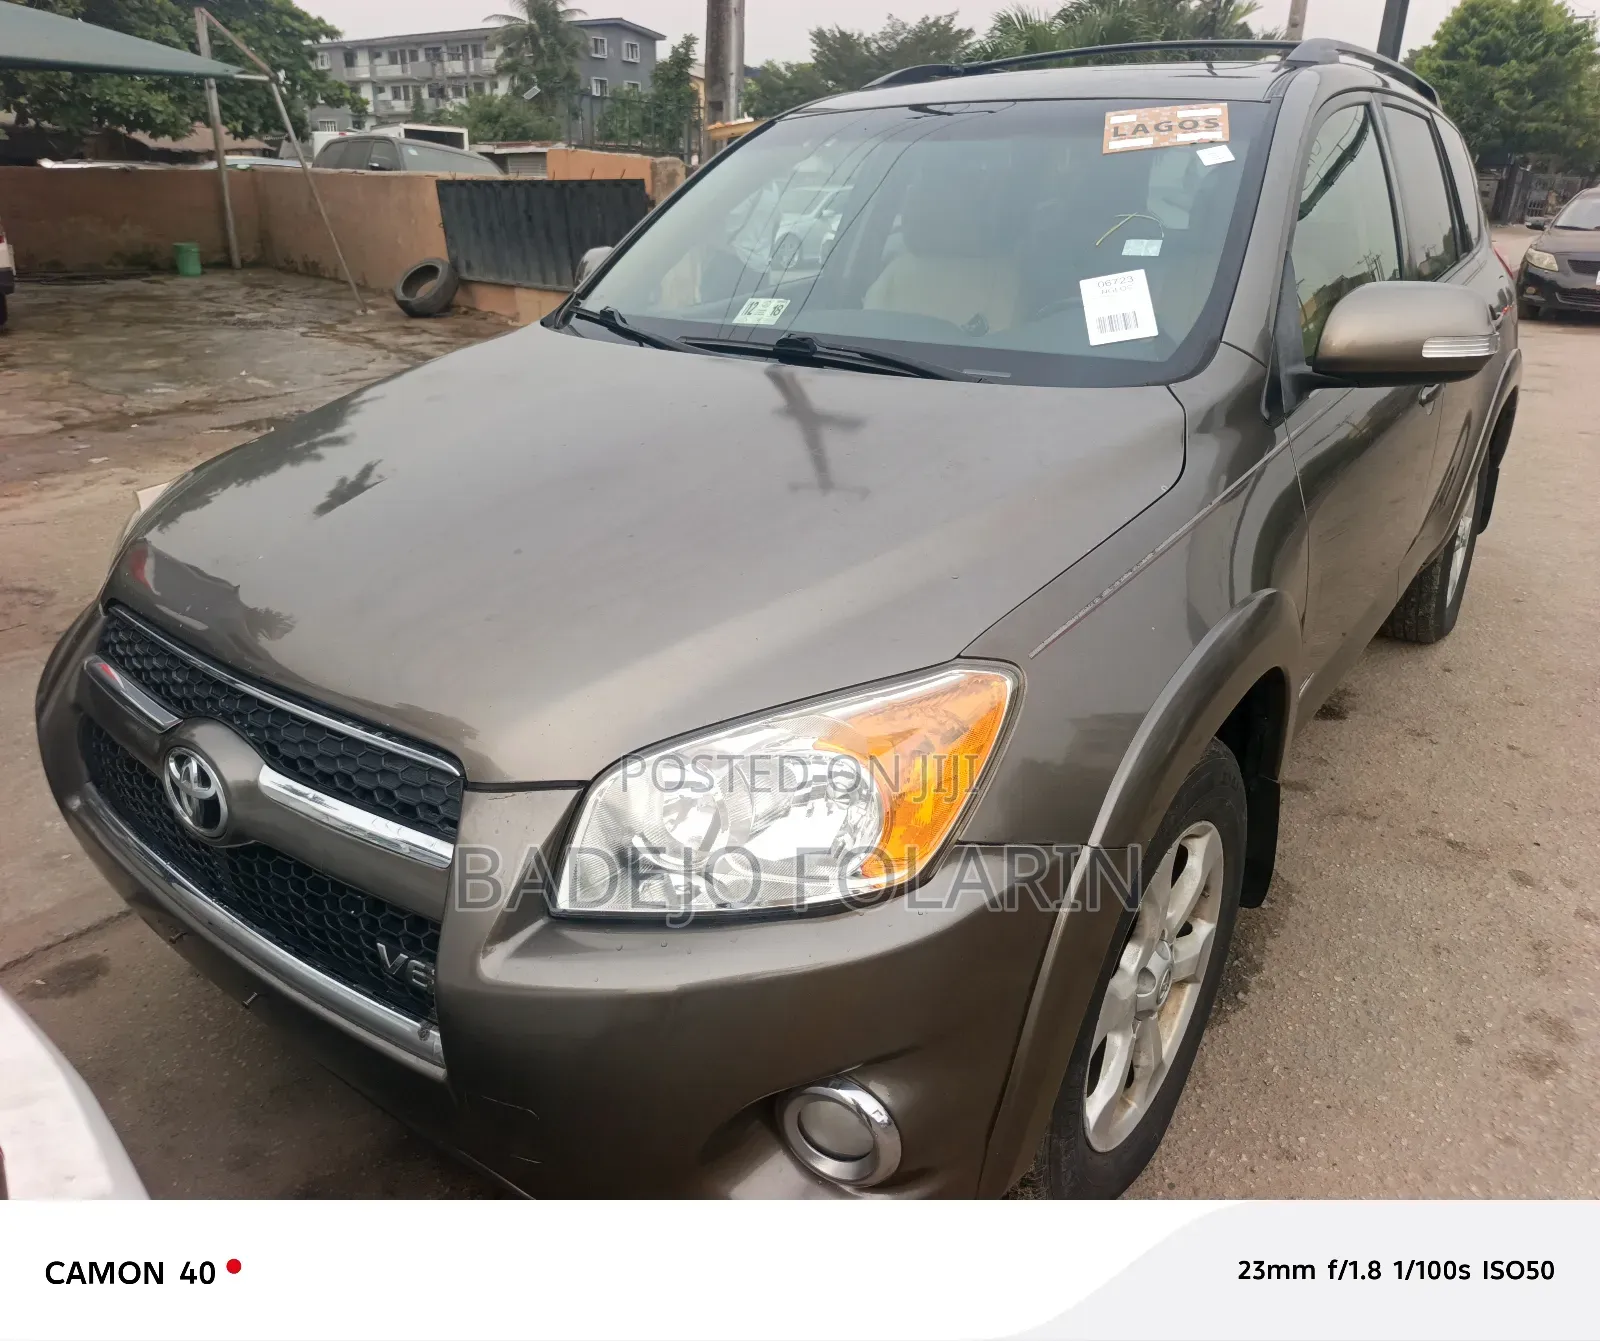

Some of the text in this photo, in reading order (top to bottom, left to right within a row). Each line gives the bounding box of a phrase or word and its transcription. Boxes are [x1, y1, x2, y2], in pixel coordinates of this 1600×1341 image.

[1112, 117, 1220, 138] LAGOS
[1097, 275, 1134, 288] 06723
[742, 301, 759, 316] 12
